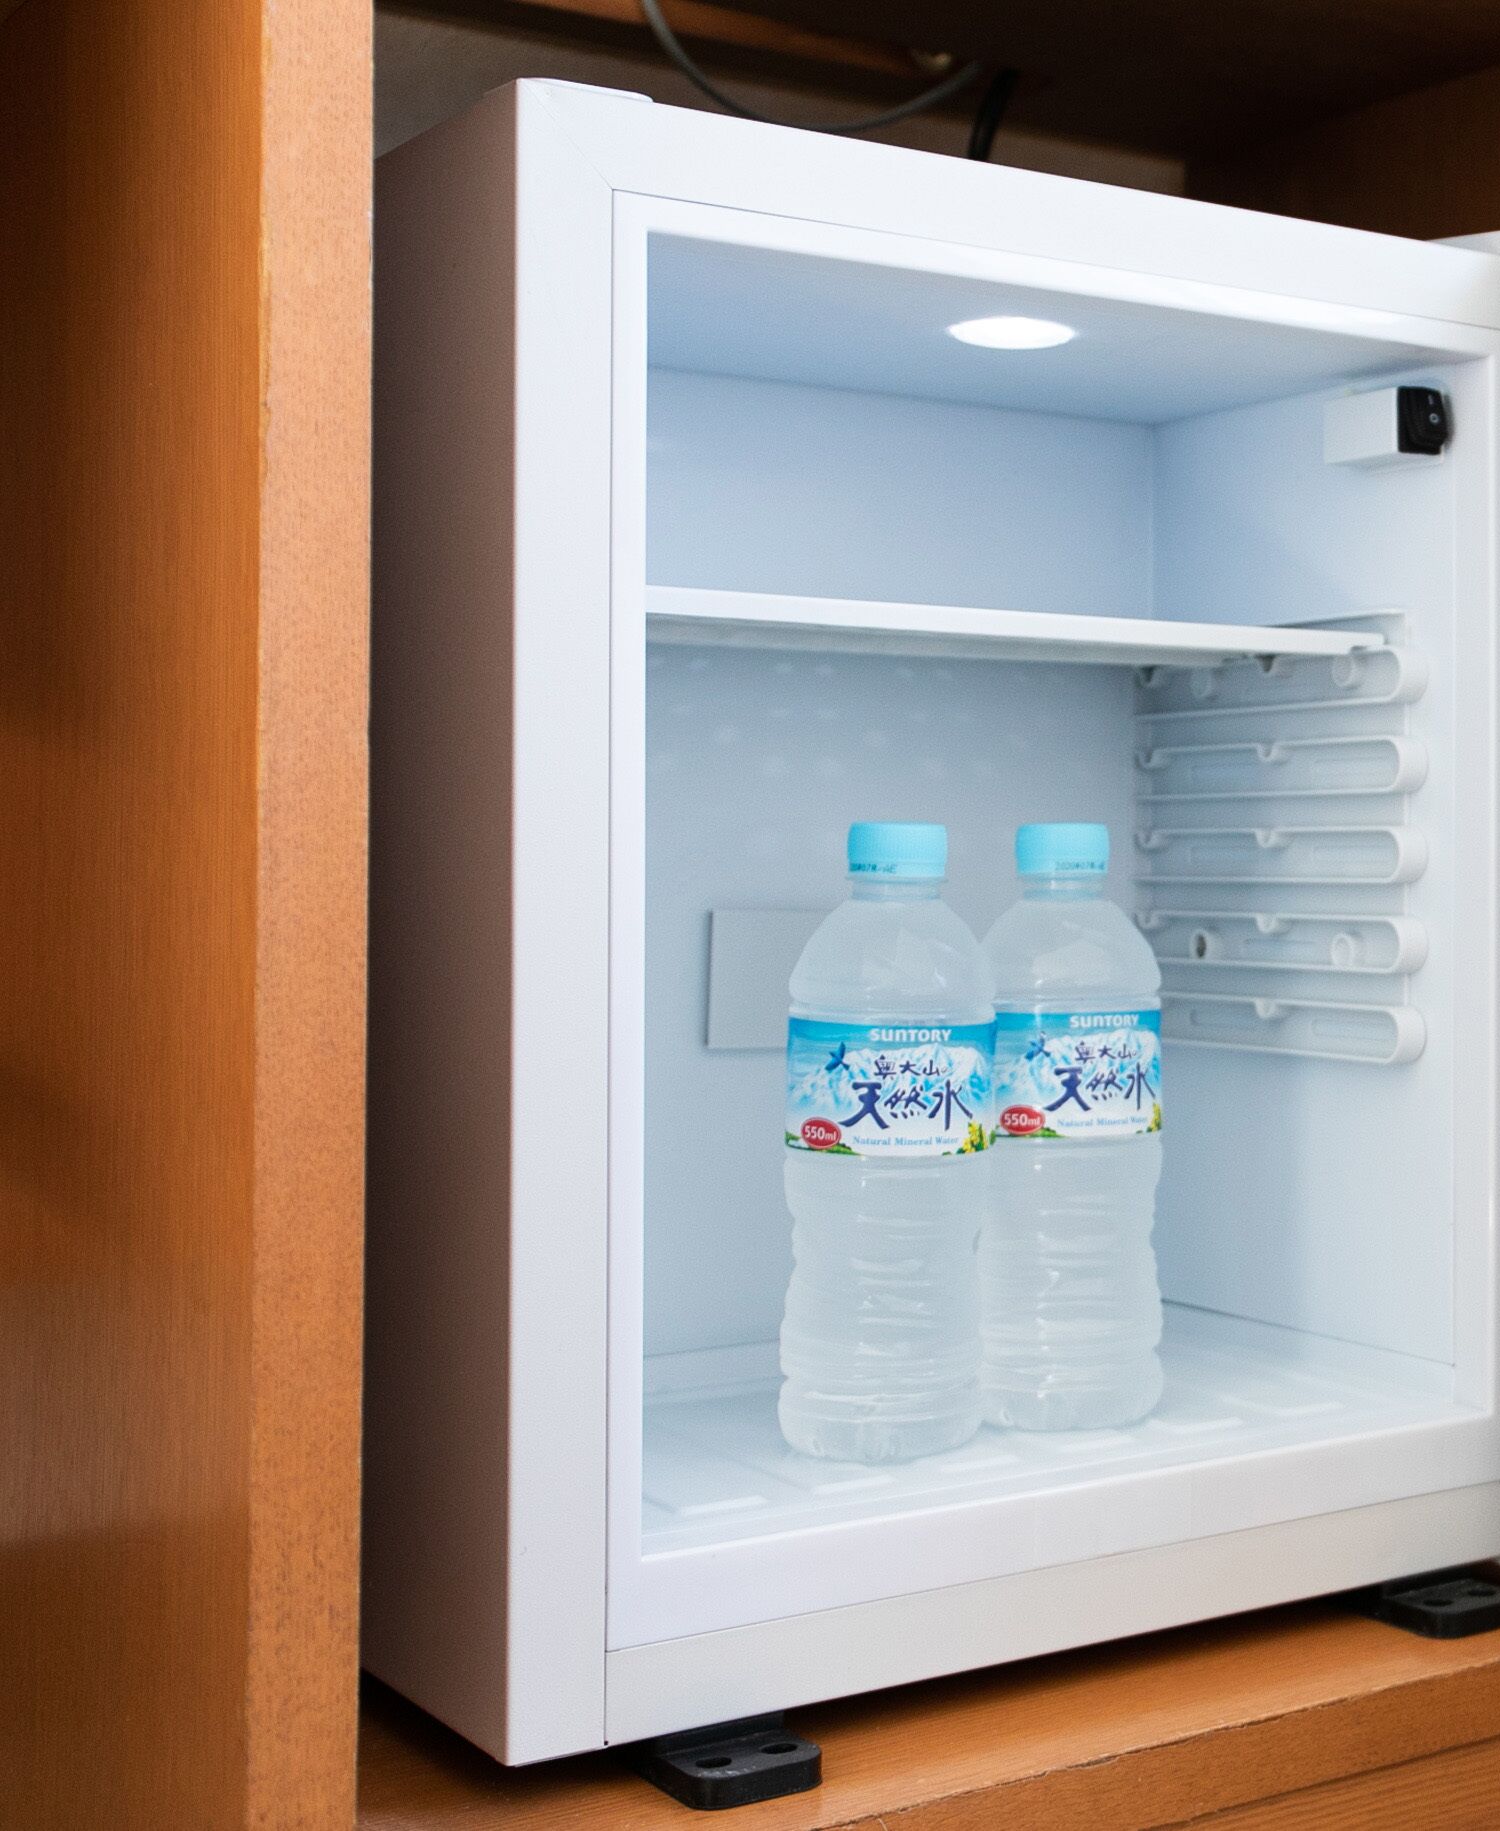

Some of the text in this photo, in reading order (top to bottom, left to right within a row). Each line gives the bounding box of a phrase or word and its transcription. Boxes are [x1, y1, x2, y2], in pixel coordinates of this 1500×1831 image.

[1070, 1014, 1139, 1028] SUNTORY
[870, 1028, 952, 1042] SUNTORY
[1043, 1062, 1156, 1111] 天然水
[838, 1079, 973, 1131] 天然水
[1003, 1113, 1041, 1126] 550ml
[1057, 1118, 1093, 1127] Natural
[1096, 1117, 1128, 1126] Mineral
[804, 1125, 837, 1142] 550ml
[852, 1136, 959, 1146] Natural Mineral Water
